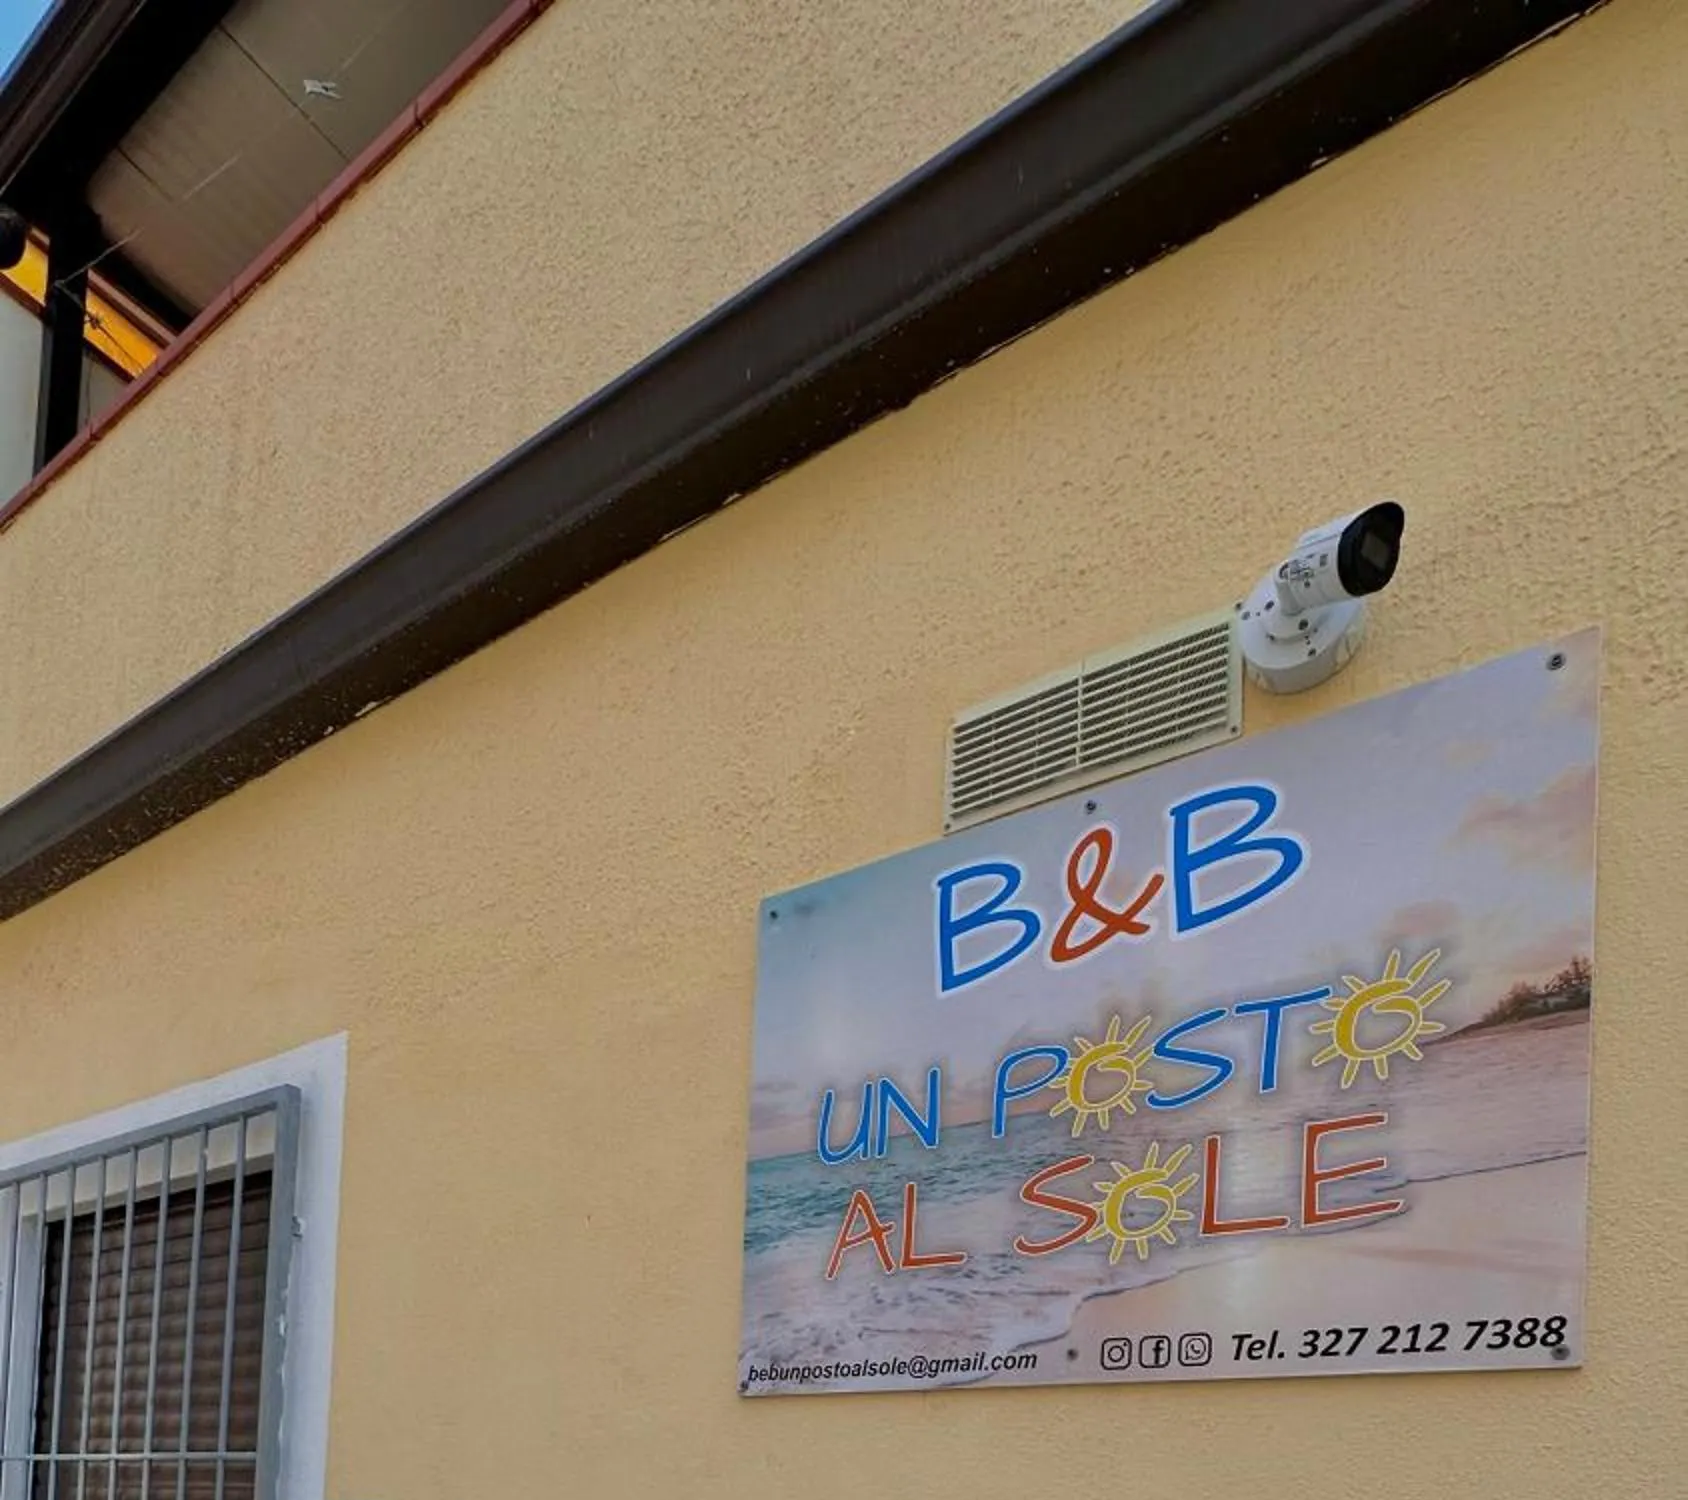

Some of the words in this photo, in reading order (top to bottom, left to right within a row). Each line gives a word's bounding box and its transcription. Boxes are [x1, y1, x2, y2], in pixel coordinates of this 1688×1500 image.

[936, 785, 1304, 993] B&B
[818, 1068, 940, 1165] UN
[992, 948, 1452, 1138] POSTO
[826, 1183, 967, 1280] AL
[1014, 1113, 1404, 1264] SOLE
[748, 1352, 1037, 1383] bebunpostoalsole@gmail.com
[1231, 1331, 1285, 1361] Tel.
[1298, 1325, 1369, 1358] 327
[1376, 1322, 1450, 1355] 212
[1463, 1315, 1568, 1351] 7388
